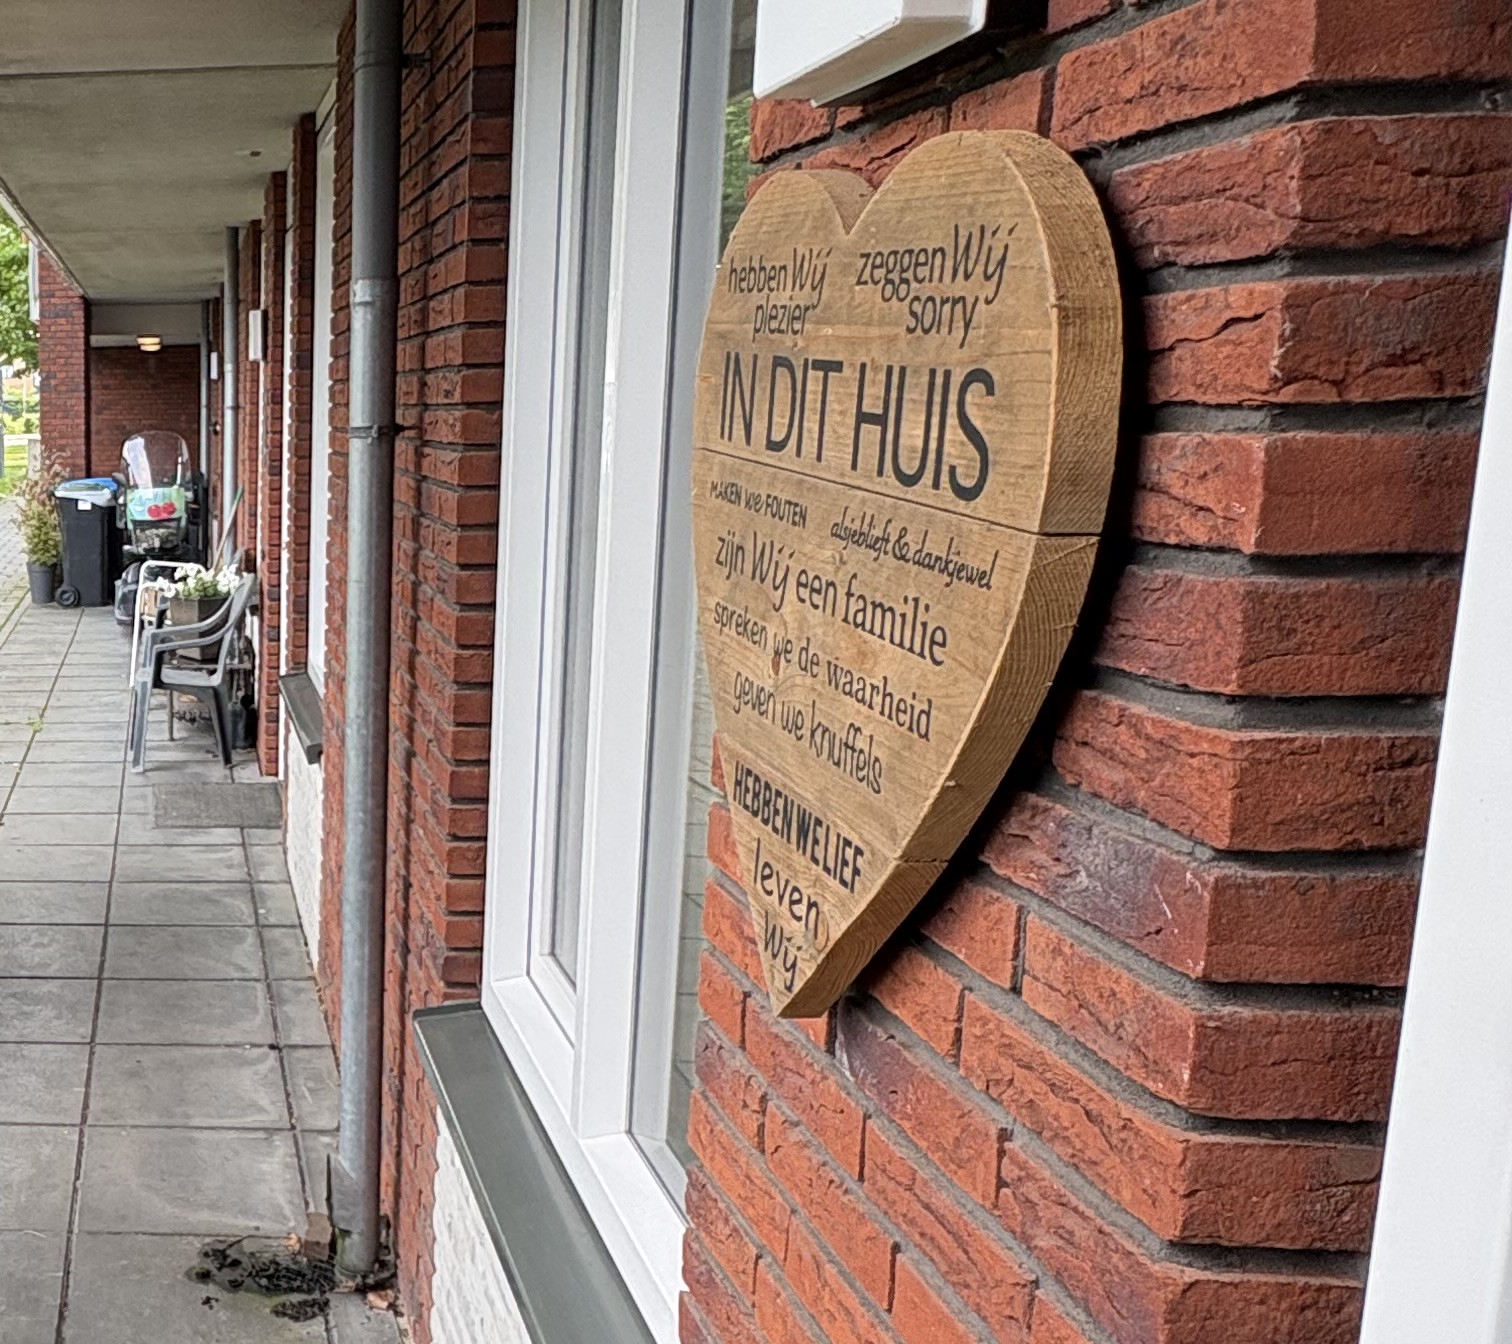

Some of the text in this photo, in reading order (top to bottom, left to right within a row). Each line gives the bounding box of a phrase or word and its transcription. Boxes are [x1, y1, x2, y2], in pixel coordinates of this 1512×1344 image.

[727, 255, 787, 294] hebben
[752, 293, 811, 342] plezier
[855, 246, 945, 303] zeggen
[905, 294, 978, 349] sorry
[719, 351, 995, 502] IN DIT HUIS
[709, 480, 742, 507] MAKEN
[764, 493, 808, 529] FOUTEN
[830, 506, 1000, 591] alsjeblieft & dankjewel
[715, 529, 746, 581] zijn
[795, 567, 838, 618] een
[841, 572, 949, 667] familie
[713, 600, 934, 743] spreken we de waarheid
[733, 670, 883, 795] geven we knuffels
[732, 759, 865, 895] HEBBEN WE LIEF
[753, 836, 821, 941] leven
